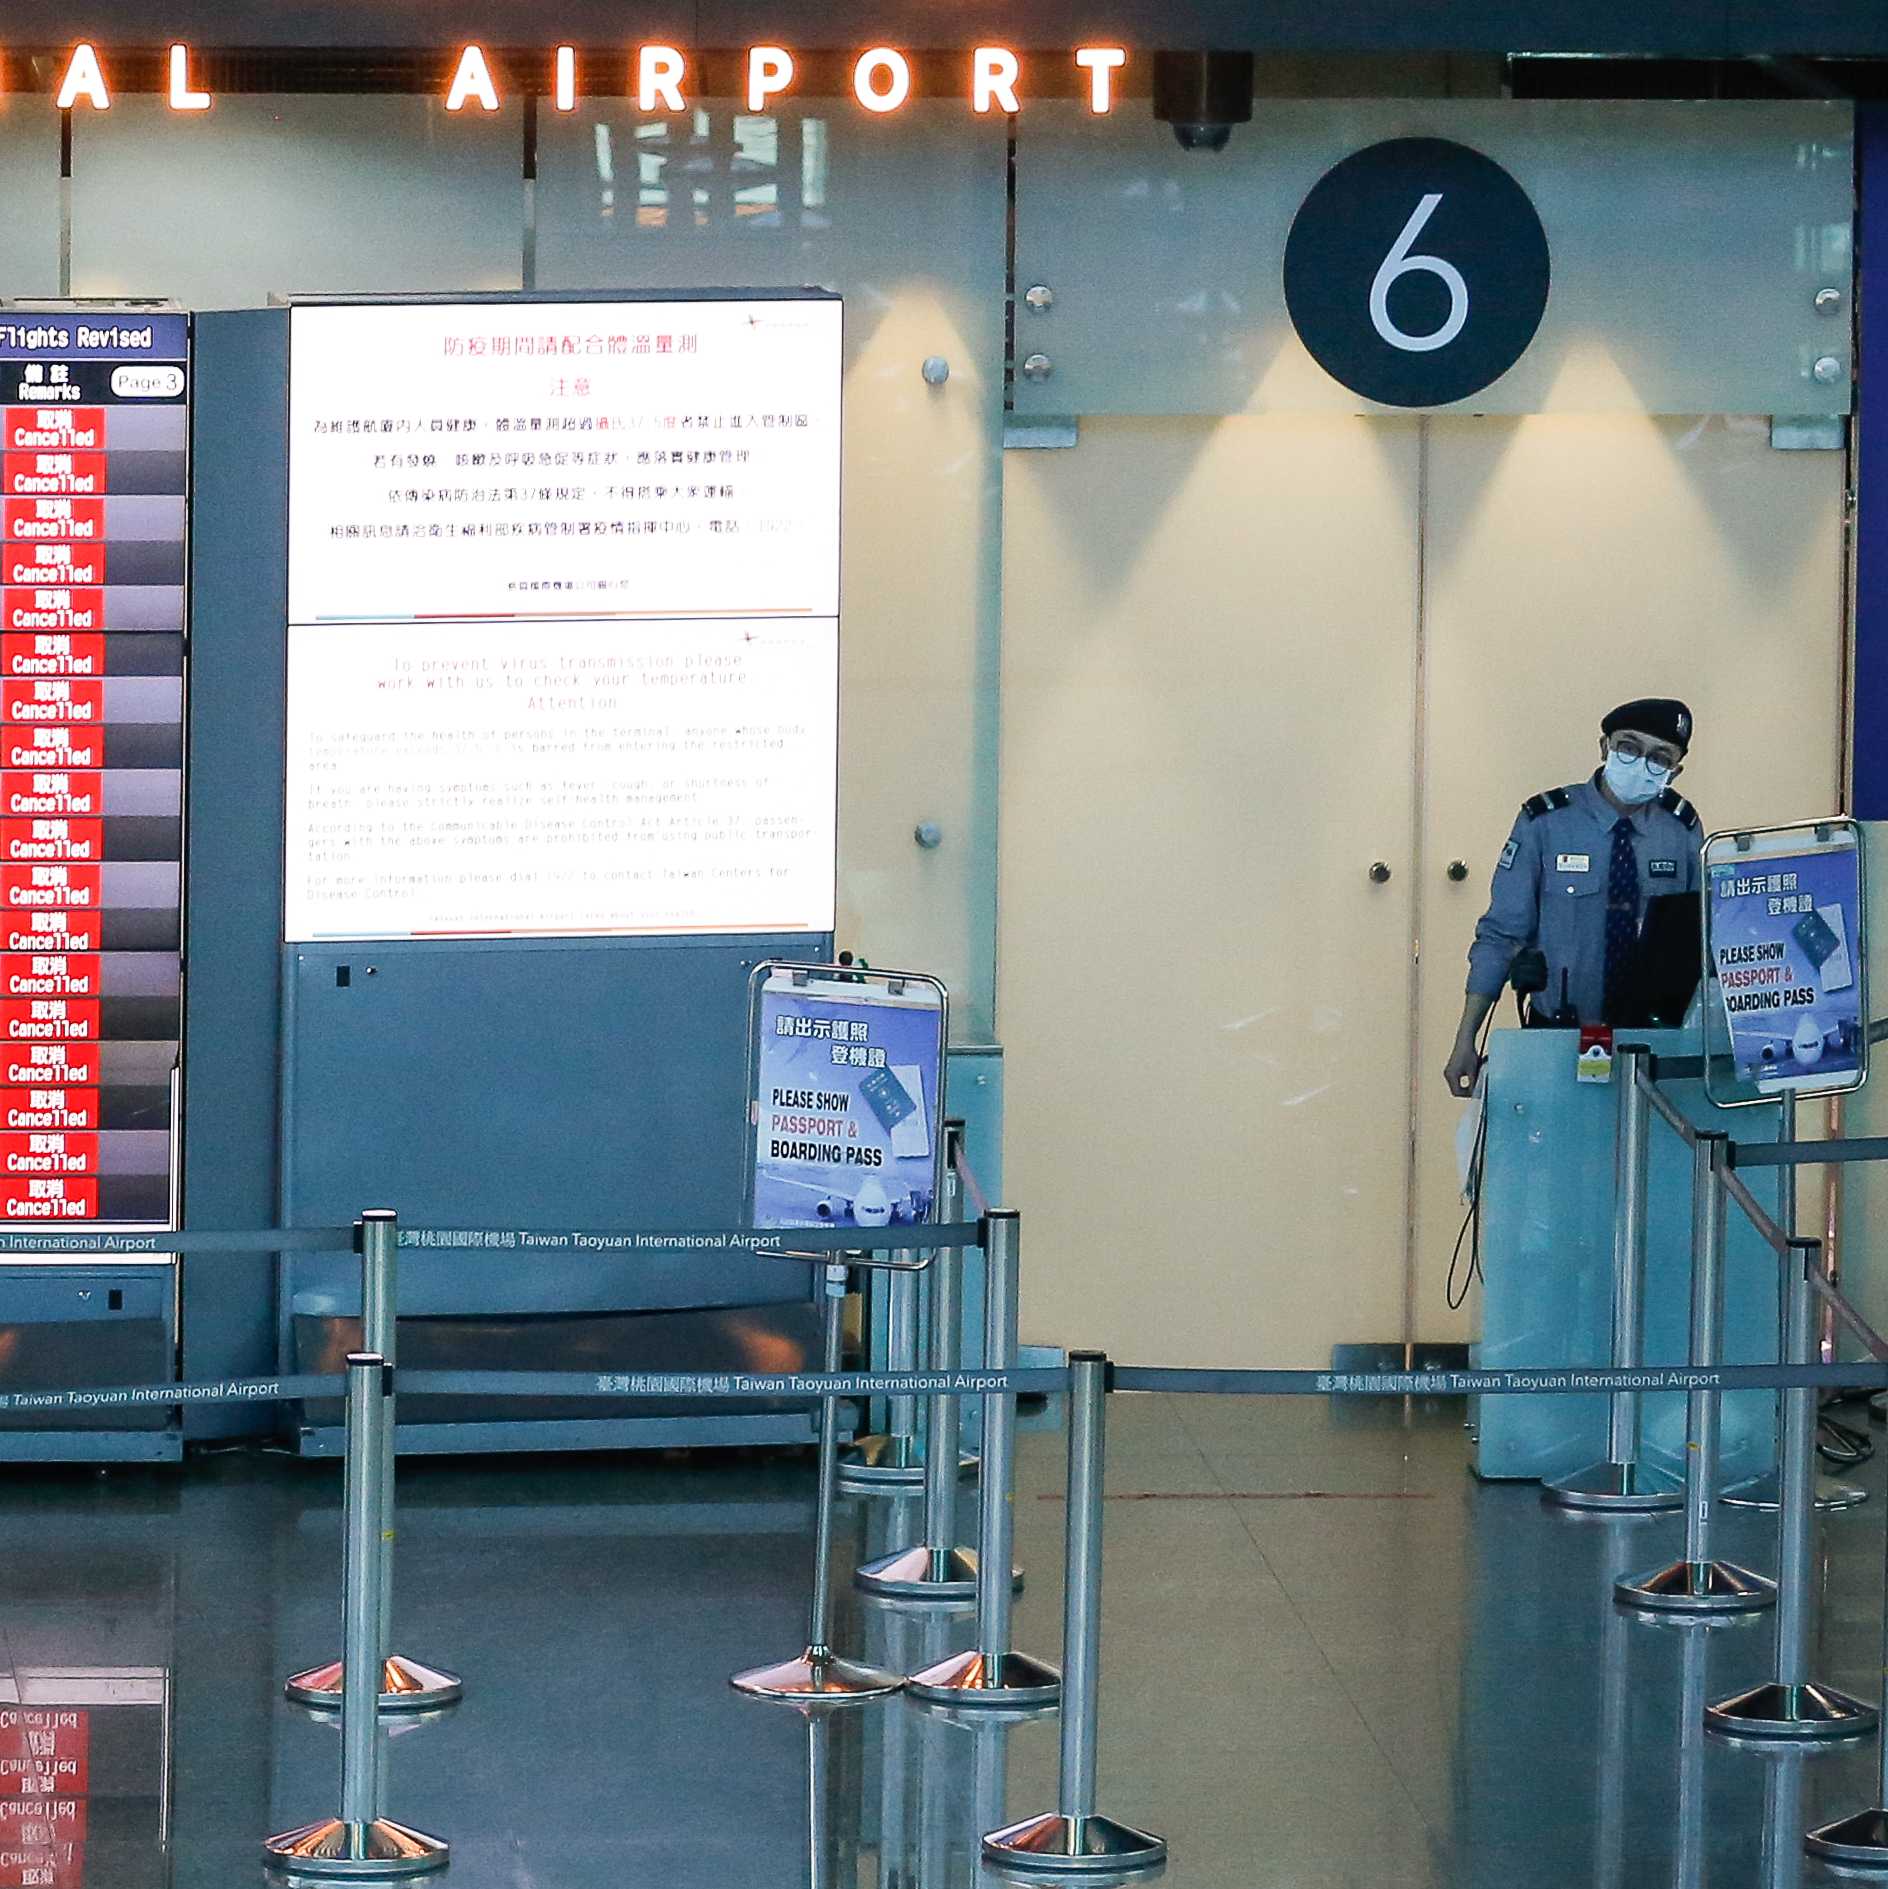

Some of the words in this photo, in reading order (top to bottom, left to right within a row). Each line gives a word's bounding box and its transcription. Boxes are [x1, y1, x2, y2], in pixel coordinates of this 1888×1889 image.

[446, 46, 1125, 112] AIRPORT
[1370, 194, 1468, 351] 6
[19, 383, 80, 400] Remarks
[118, 375, 162, 393] Page
[165, 374, 178, 391] 3
[14, 428, 94, 446] Cancelled
[393, 657, 412, 672] To
[422, 657, 489, 673] prevent
[501, 656, 547, 670] virus
[559, 654, 674, 670] transmission
[685, 652, 742, 670] please
[378, 675, 415, 690] work
[426, 674, 465, 690] with
[476, 675, 494, 689] us
[505, 674, 523, 689] to
[534, 672, 581, 688] check
[593, 672, 630, 689] your
[528, 694, 617, 710] Attention
[1720, 945, 1754, 965] PLEASE
[1757, 943, 1784, 961] SHOW
[1722, 967, 1780, 988] PASSPORT
[1784, 988, 1814, 1006] PASS
[776, 1015, 868, 1042] 請出示護照
[773, 1089, 813, 1109] PLEASE
[817, 1092, 849, 1112] SHOW
[772, 1115, 844, 1137] PASSPORT
[848, 1123, 857, 1138] &
[771, 1140, 841, 1163] BOARDING
[846, 1146, 882, 1167] PASS
[734, 1376, 784, 1391] Taiwan
[789, 1376, 851, 1394] Taoyuan
[855, 1375, 950, 1389] International
[954, 1375, 1008, 1391] Airport
